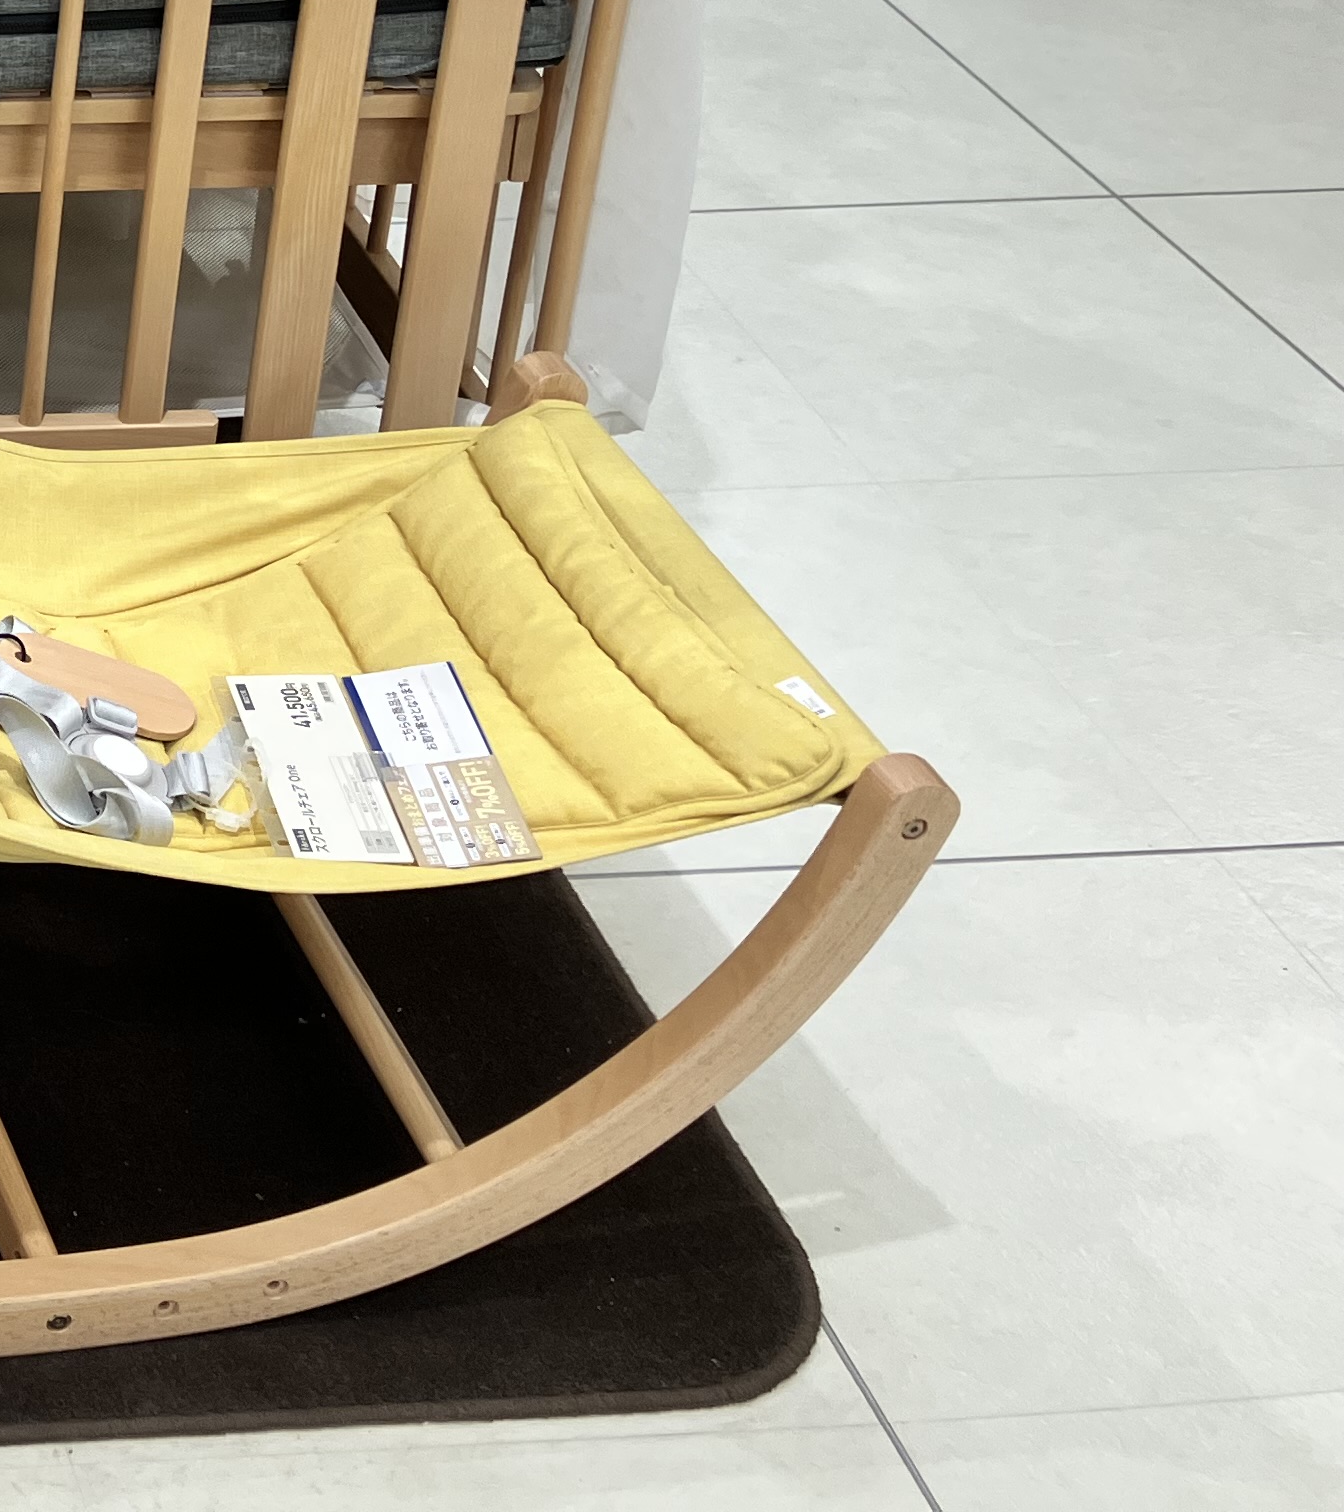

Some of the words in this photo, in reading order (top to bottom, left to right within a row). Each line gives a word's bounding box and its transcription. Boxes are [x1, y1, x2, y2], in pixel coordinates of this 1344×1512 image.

[280, 682, 312, 729] 41,500円
[385, 690, 418, 742] こちらの商品は
[398, 678, 439, 751] お取り寄せとなります。
[285, 763, 302, 782] One
[458, 758, 506, 821] 7%OFF!
[292, 783, 330, 854] スクロールチェア
